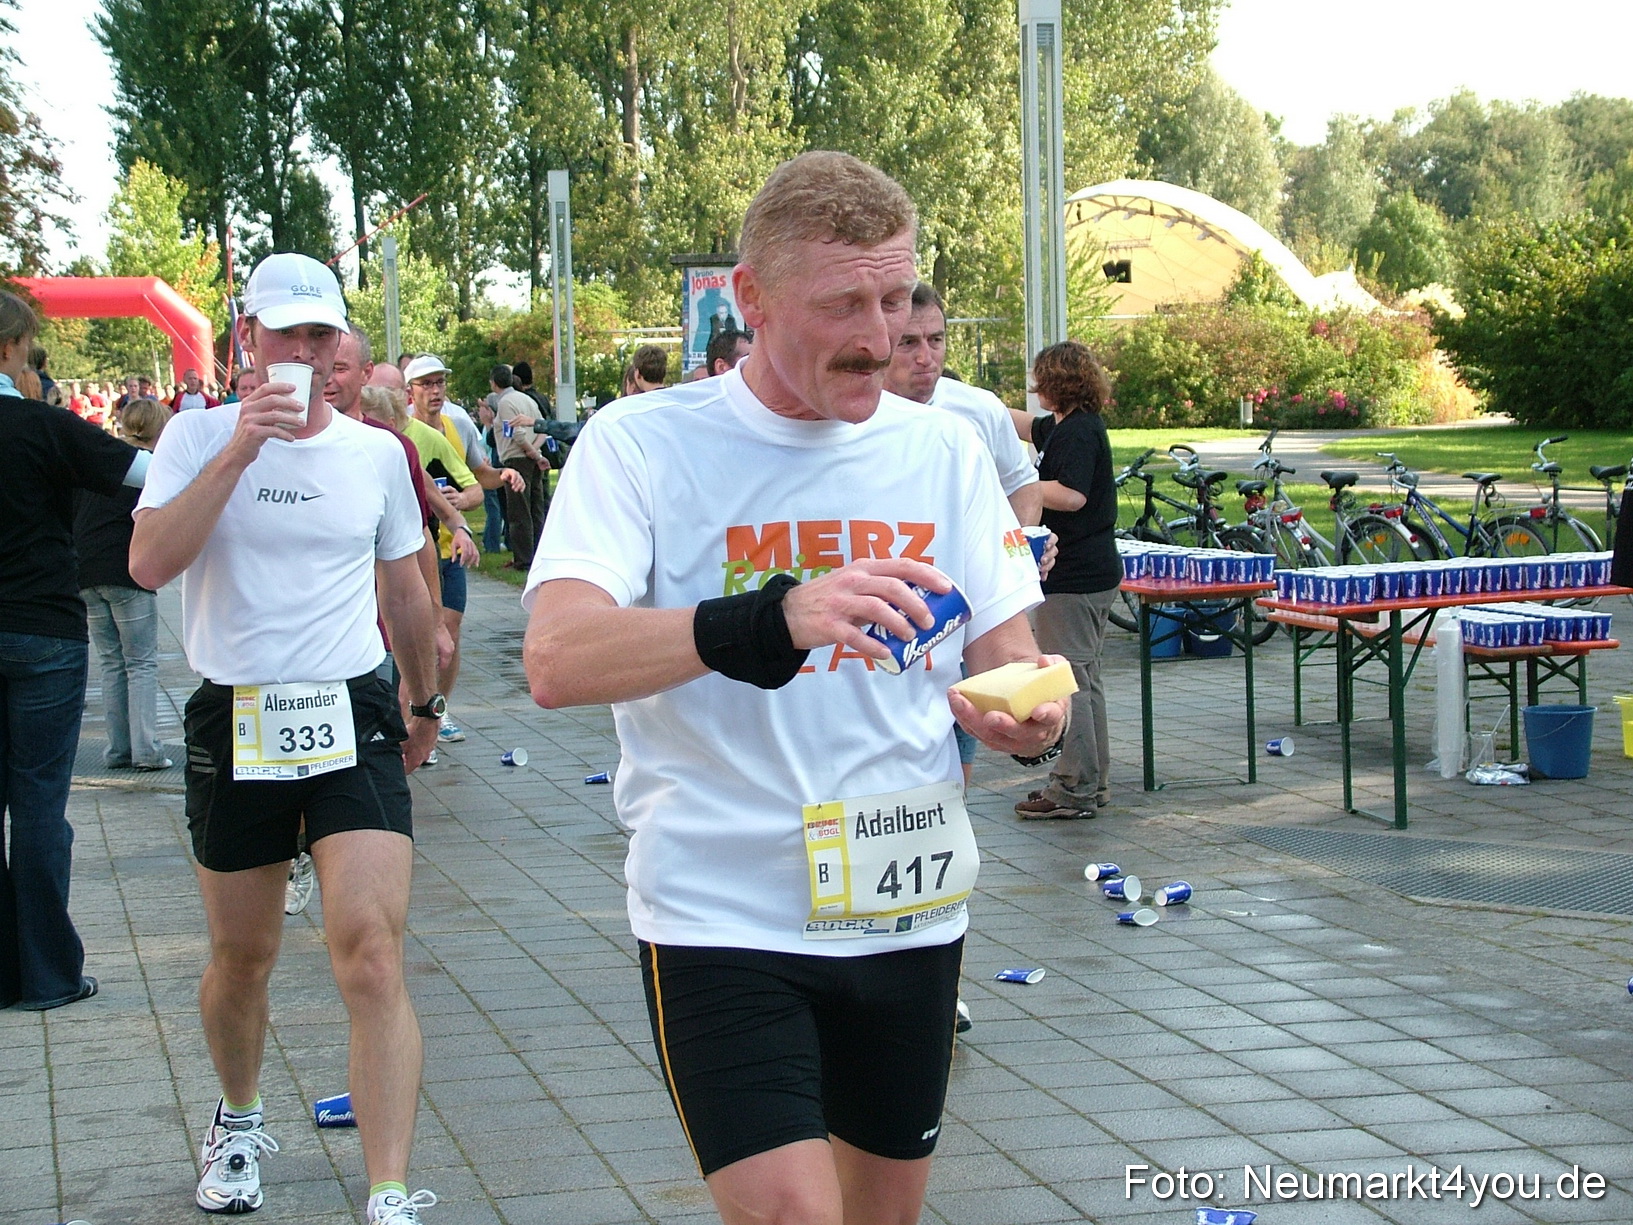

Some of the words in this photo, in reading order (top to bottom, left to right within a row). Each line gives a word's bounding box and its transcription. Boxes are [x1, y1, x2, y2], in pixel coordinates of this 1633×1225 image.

[291, 284, 321, 293] GORE
[257, 488, 298, 504] RUN
[726, 519, 935, 573] MERZ
[264, 690, 338, 711] Alexander
[238, 723, 246, 736] B
[279, 723, 335, 753] 333
[310, 755, 354, 770] PFLEIDERER
[855, 803, 946, 839] Adalbert
[818, 863, 829, 883] B
[876, 850, 954, 899] 417
